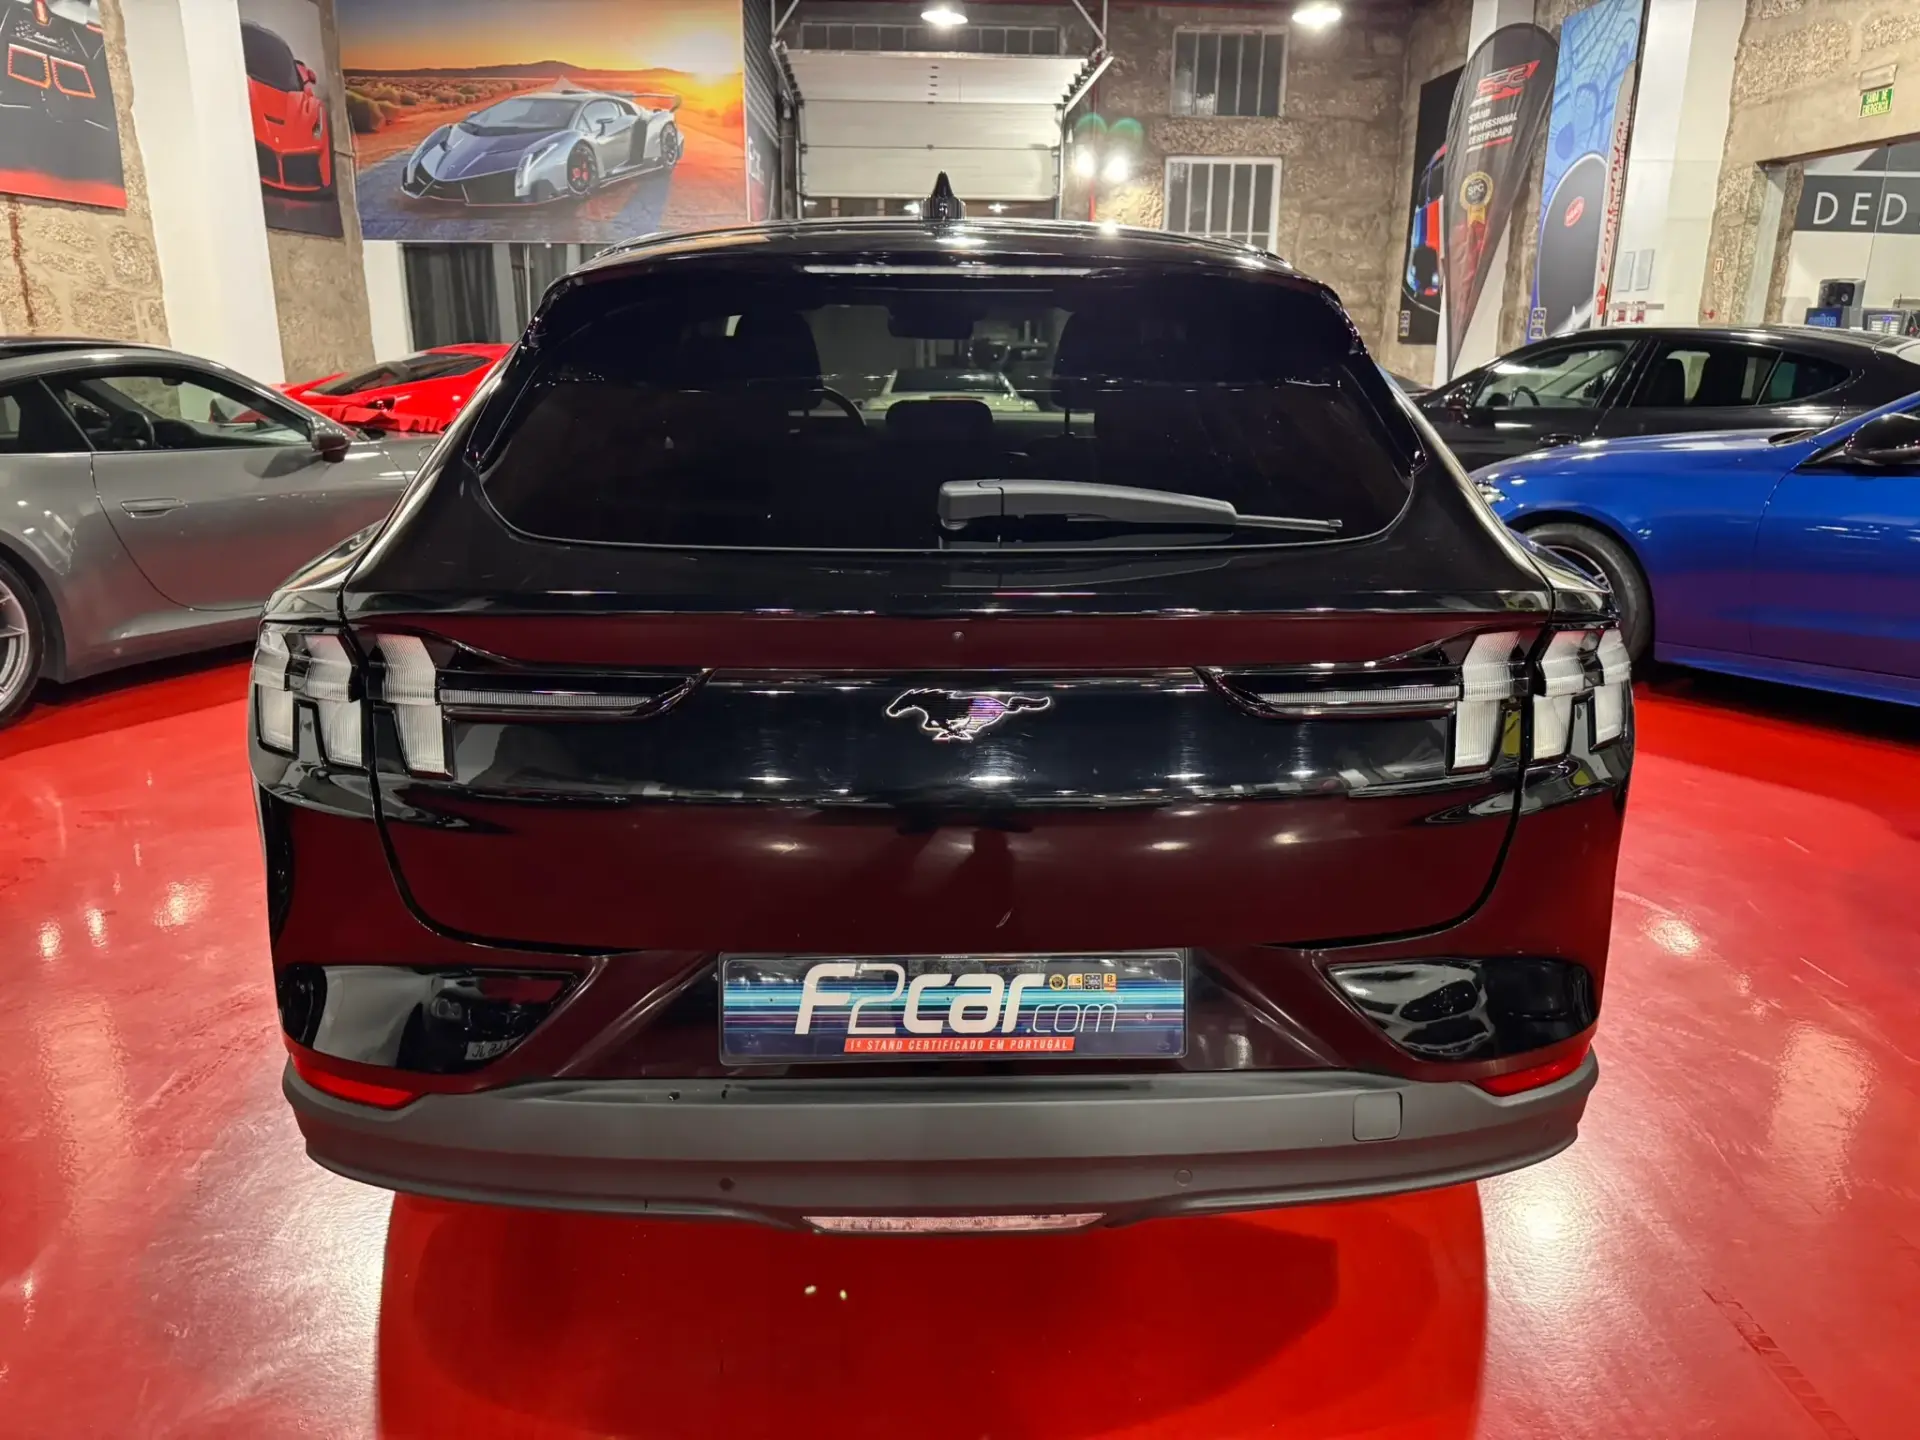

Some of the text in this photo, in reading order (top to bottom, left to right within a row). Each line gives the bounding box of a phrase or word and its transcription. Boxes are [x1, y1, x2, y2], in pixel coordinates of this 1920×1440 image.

[1813, 191, 1920, 227] DED
[866, 1039, 903, 1051] STAND
[908, 1039, 984, 1051] CERTIFICADO
[989, 1039, 1005, 1051] EM
[1010, 1038, 1068, 1050] PORTUGAL
